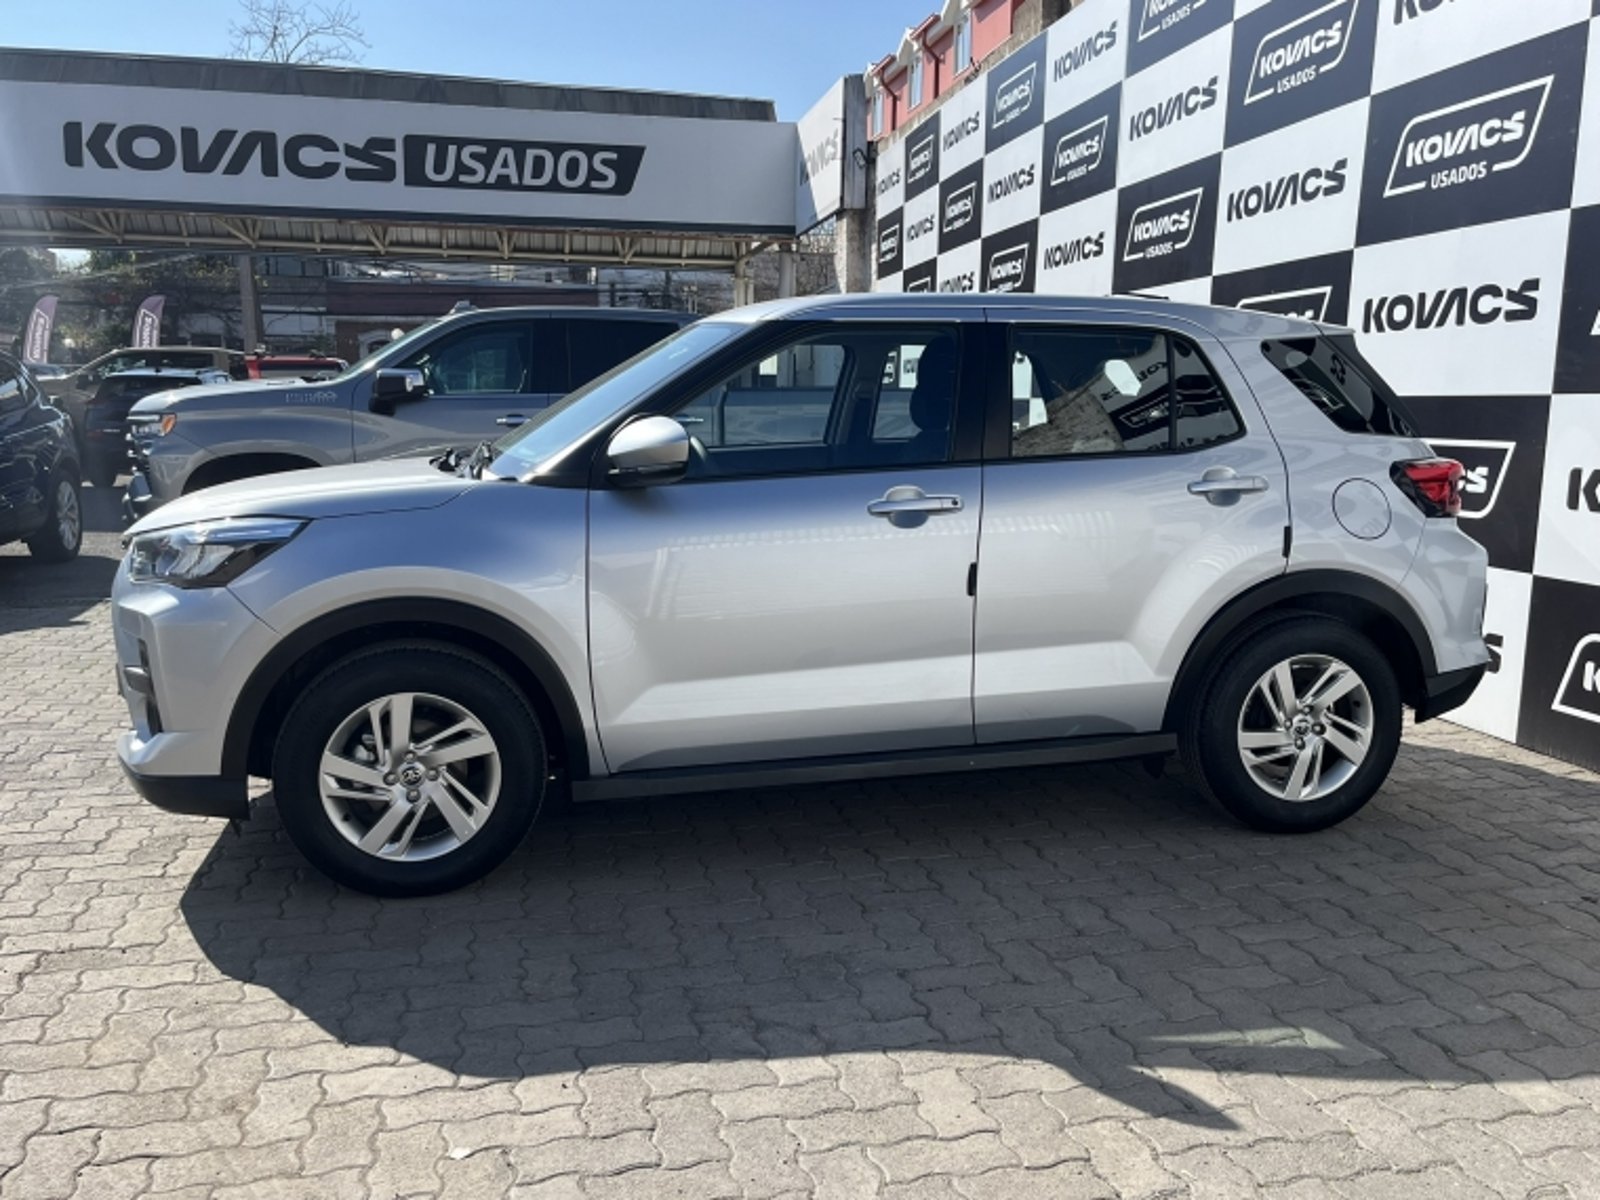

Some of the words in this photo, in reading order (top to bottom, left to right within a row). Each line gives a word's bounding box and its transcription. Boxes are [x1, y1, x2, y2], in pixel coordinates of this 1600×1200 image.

[1053, 20, 1117, 82] KOVACS
[1259, 20, 1342, 78] KOVACS
[1276, 65, 1317, 94] USADOS
[943, 110, 980, 152] KOVACS
[1129, 75, 1218, 142] KOVACS
[63, 121, 397, 182] KOVACS
[423, 143, 618, 190] USADOS
[1058, 134, 1100, 169] KOVACS
[1406, 110, 1526, 168] KOVACS
[987, 163, 1034, 204] KOVACS
[1227, 157, 1348, 222] KOVACS
[1431, 161, 1487, 189] USADOS
[1044, 231, 1104, 270] KOVACS
[1133, 209, 1190, 243] KOVACS
[1362, 278, 1540, 334] KOVACS
